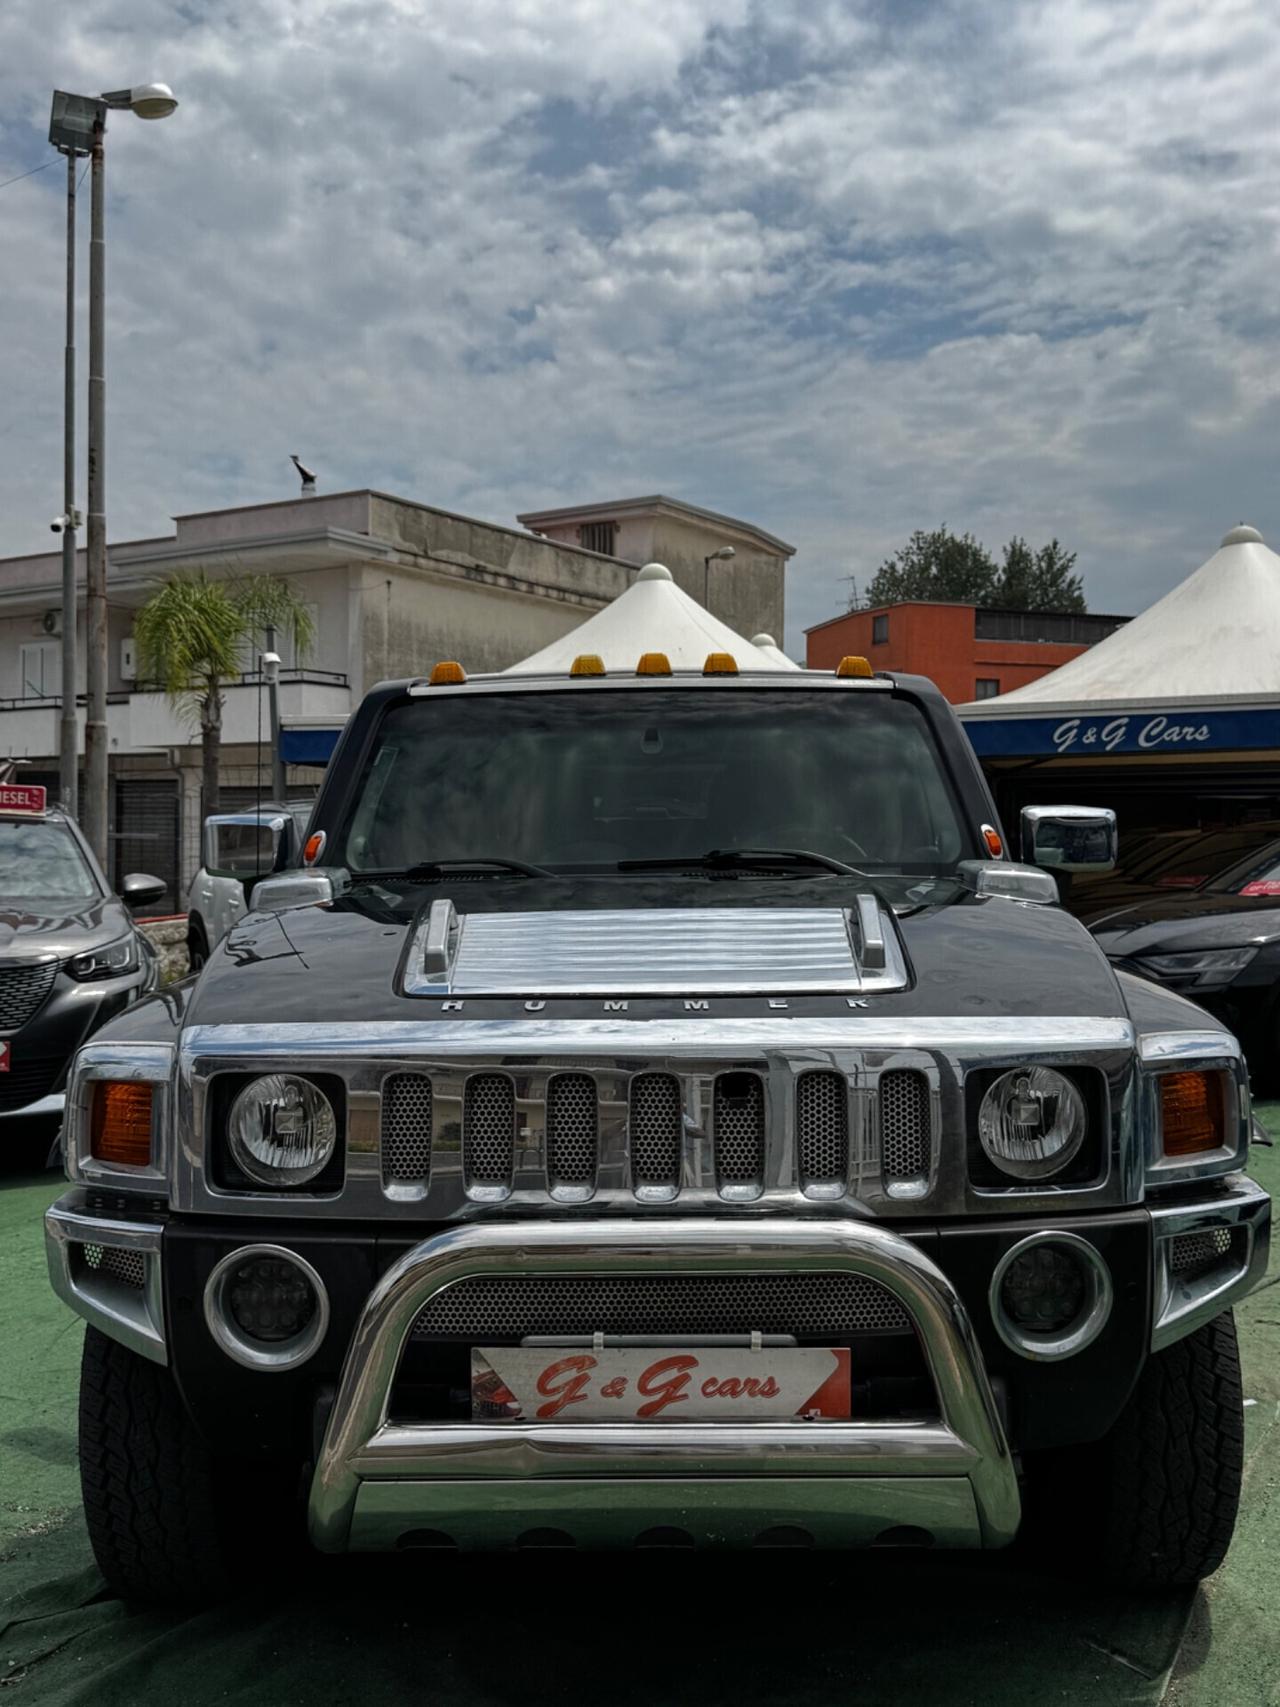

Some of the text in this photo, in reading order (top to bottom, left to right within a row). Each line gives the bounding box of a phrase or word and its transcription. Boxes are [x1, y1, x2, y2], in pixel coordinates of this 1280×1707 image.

[1138, 716, 1210, 748] Cars
[440, 999, 870, 1011] HUMMER
[701, 1376, 780, 1399] cars
